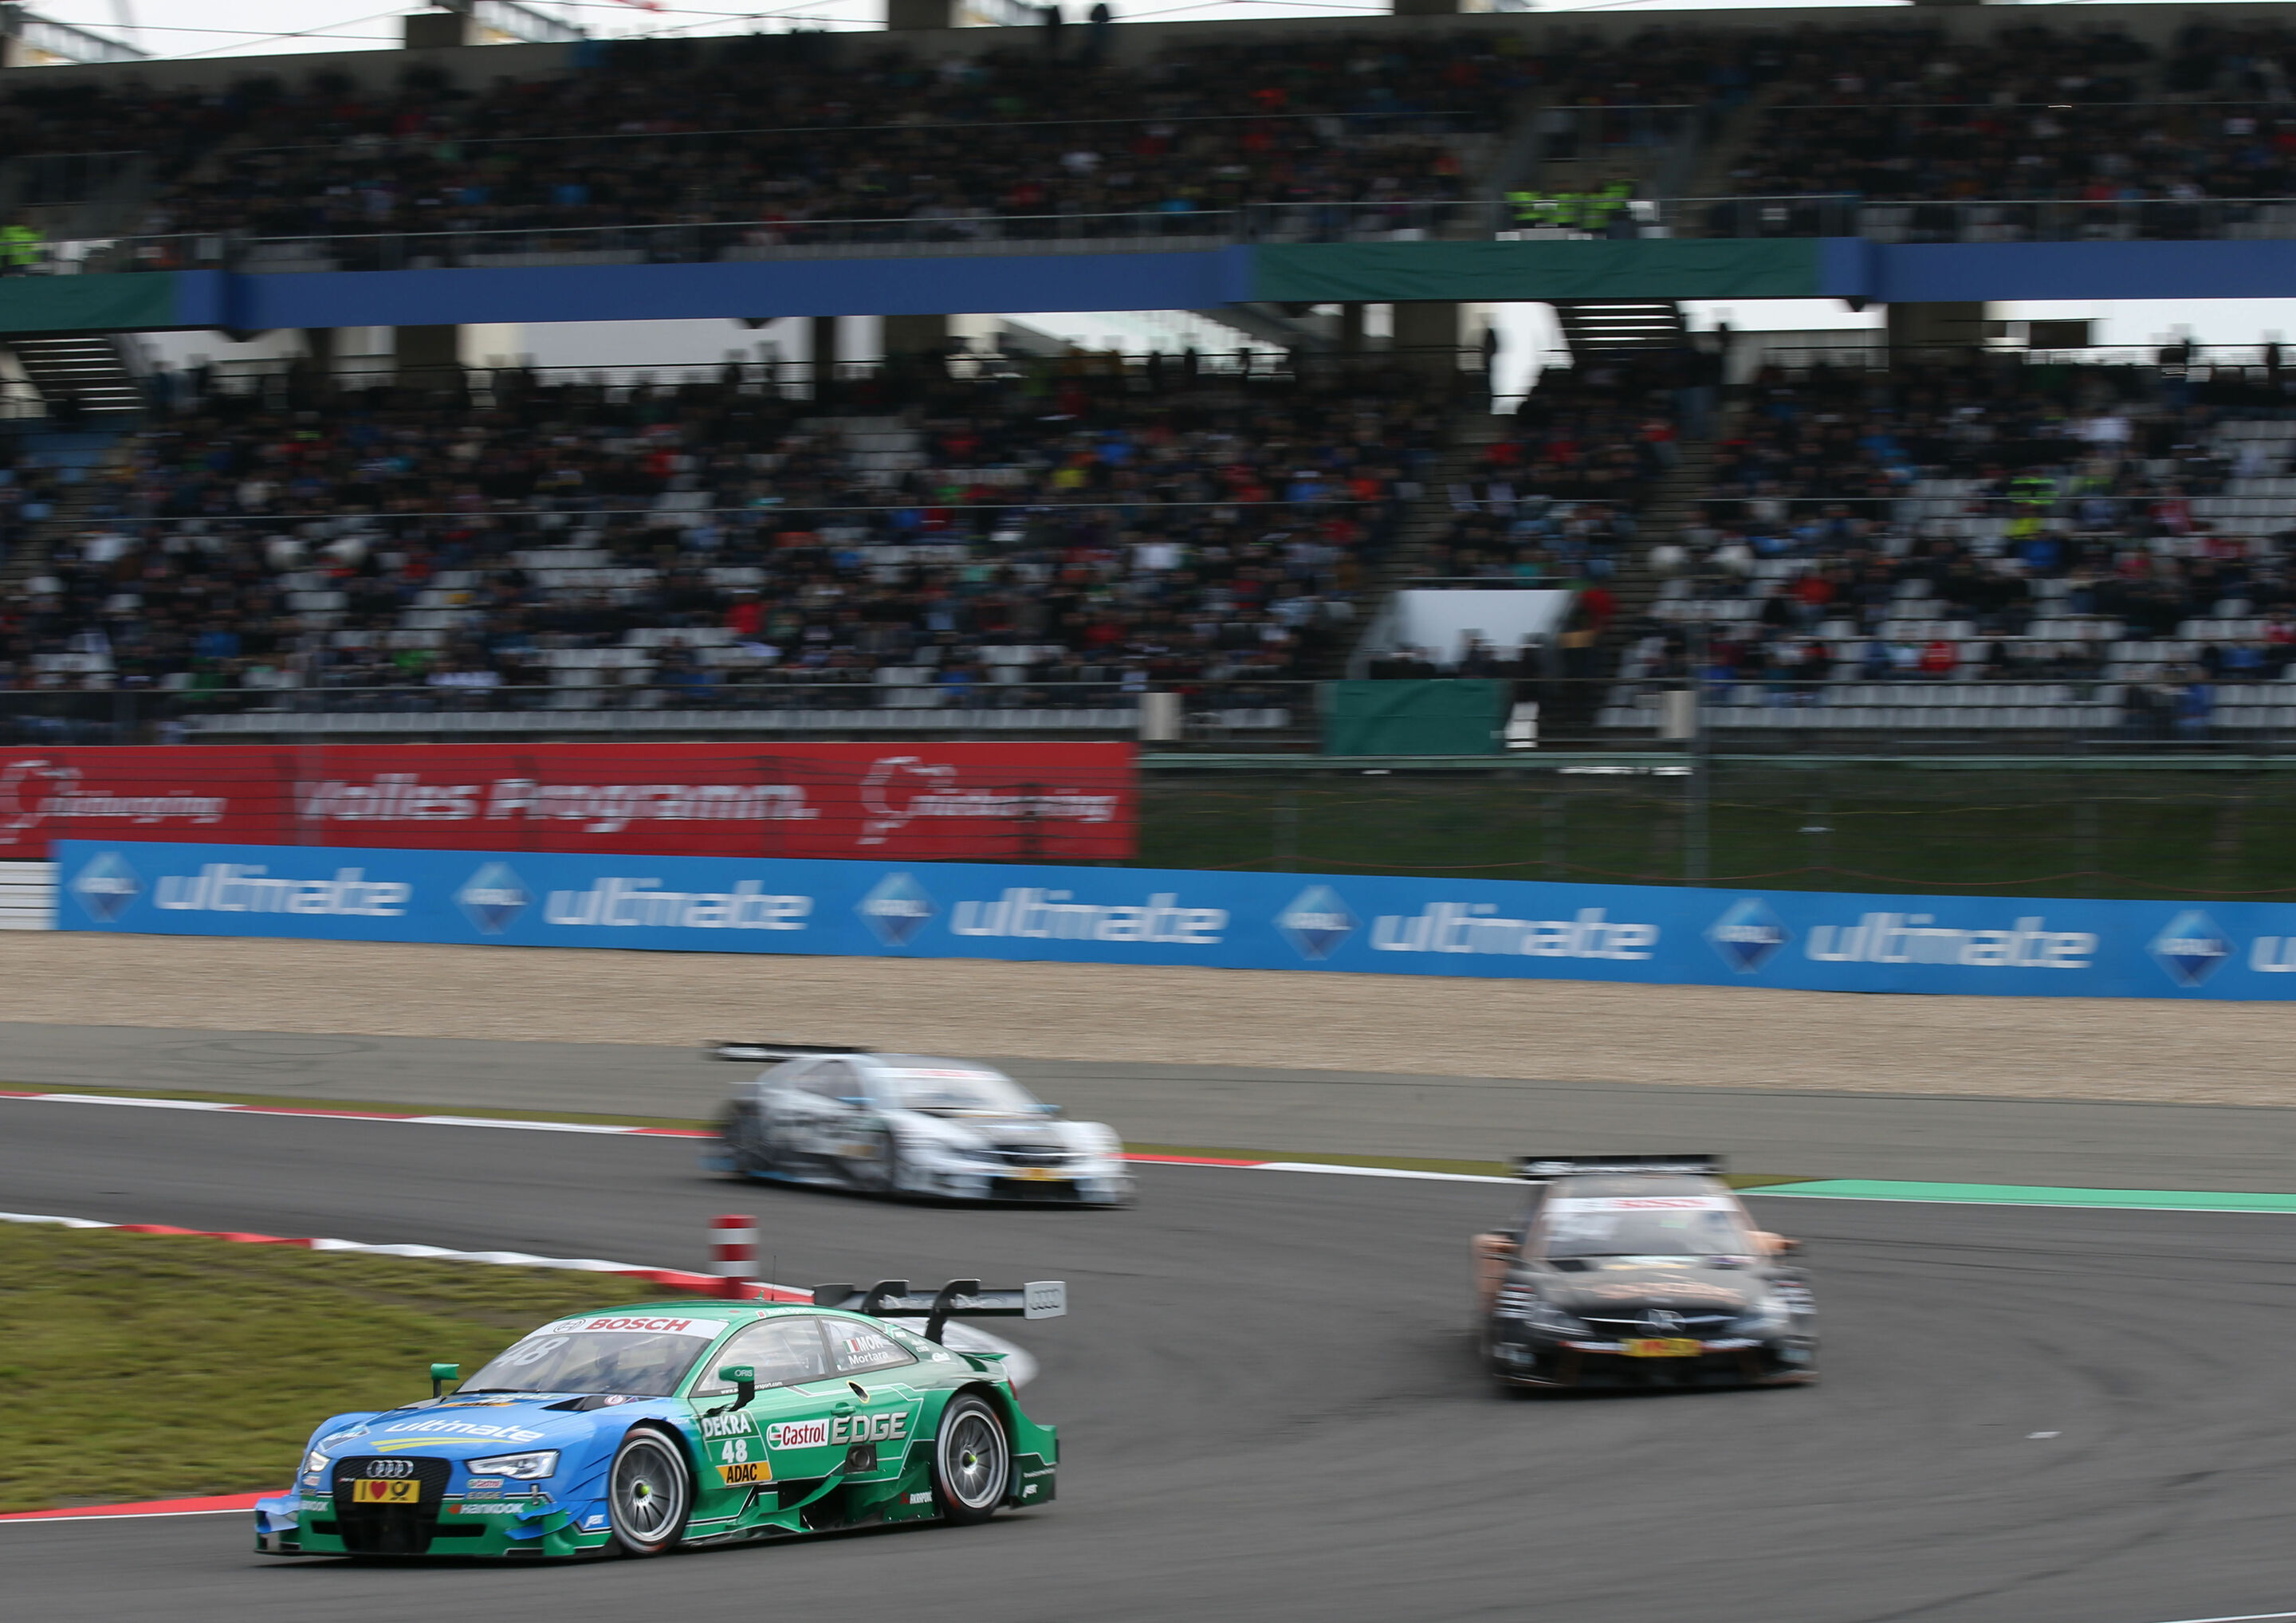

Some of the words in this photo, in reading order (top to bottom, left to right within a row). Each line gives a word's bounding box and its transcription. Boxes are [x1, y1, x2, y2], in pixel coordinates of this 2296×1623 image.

[293, 773, 482, 820] Volles
[485, 778, 821, 833] Programm.
[153, 863, 411, 916] ultimate
[544, 877, 813, 930] ultimate
[951, 887, 1229, 944] ultimate
[1370, 902, 1660, 960] ultimate
[1806, 912, 2098, 969] ultimate
[586, 1318, 692, 1331] BOSCH
[492, 1336, 570, 1368] 48
[847, 1350, 888, 1366] Mortara
[856, 1334, 884, 1352] MOR
[384, 1420, 545, 1443] ultimate
[701, 1413, 752, 1438] DEKRA
[783, 1422, 826, 1446] Castrol
[831, 1412, 909, 1446] EDGE
[721, 1439, 749, 1464] 48
[726, 1463, 757, 1483] ADAC
